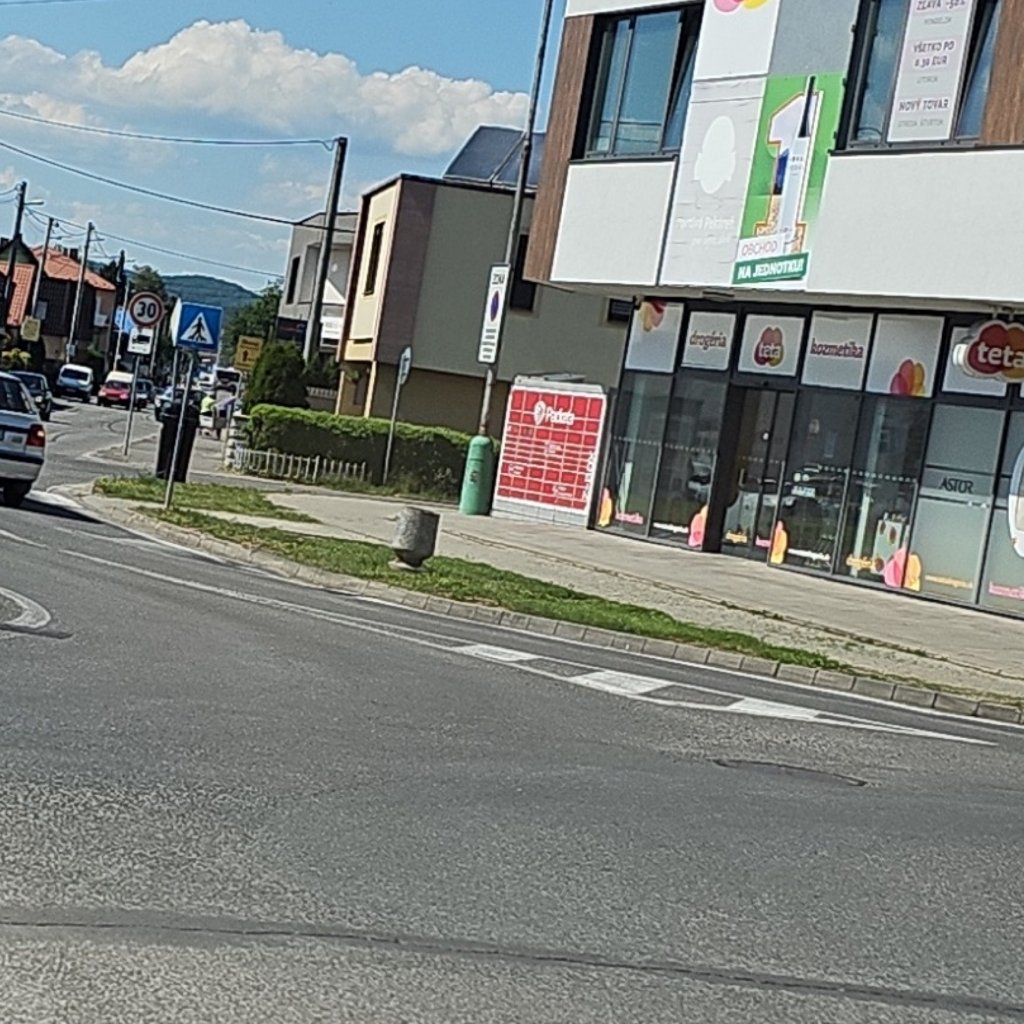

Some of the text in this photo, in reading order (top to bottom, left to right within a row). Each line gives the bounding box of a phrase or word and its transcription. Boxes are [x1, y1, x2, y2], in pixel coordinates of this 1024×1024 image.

[913, 41, 955, 53] VŠETKO PO
[922, 99, 949, 110] TOVAR
[741, 240, 778, 256] OBCHOD
[737, 265, 751, 279] NA
[137, 301, 156, 318] 30
[689, 330, 727, 350] drogéria
[810, 338, 864, 358] kozmetika
[977, 342, 1024, 368] teta
[938, 478, 974, 494] ASTOR
